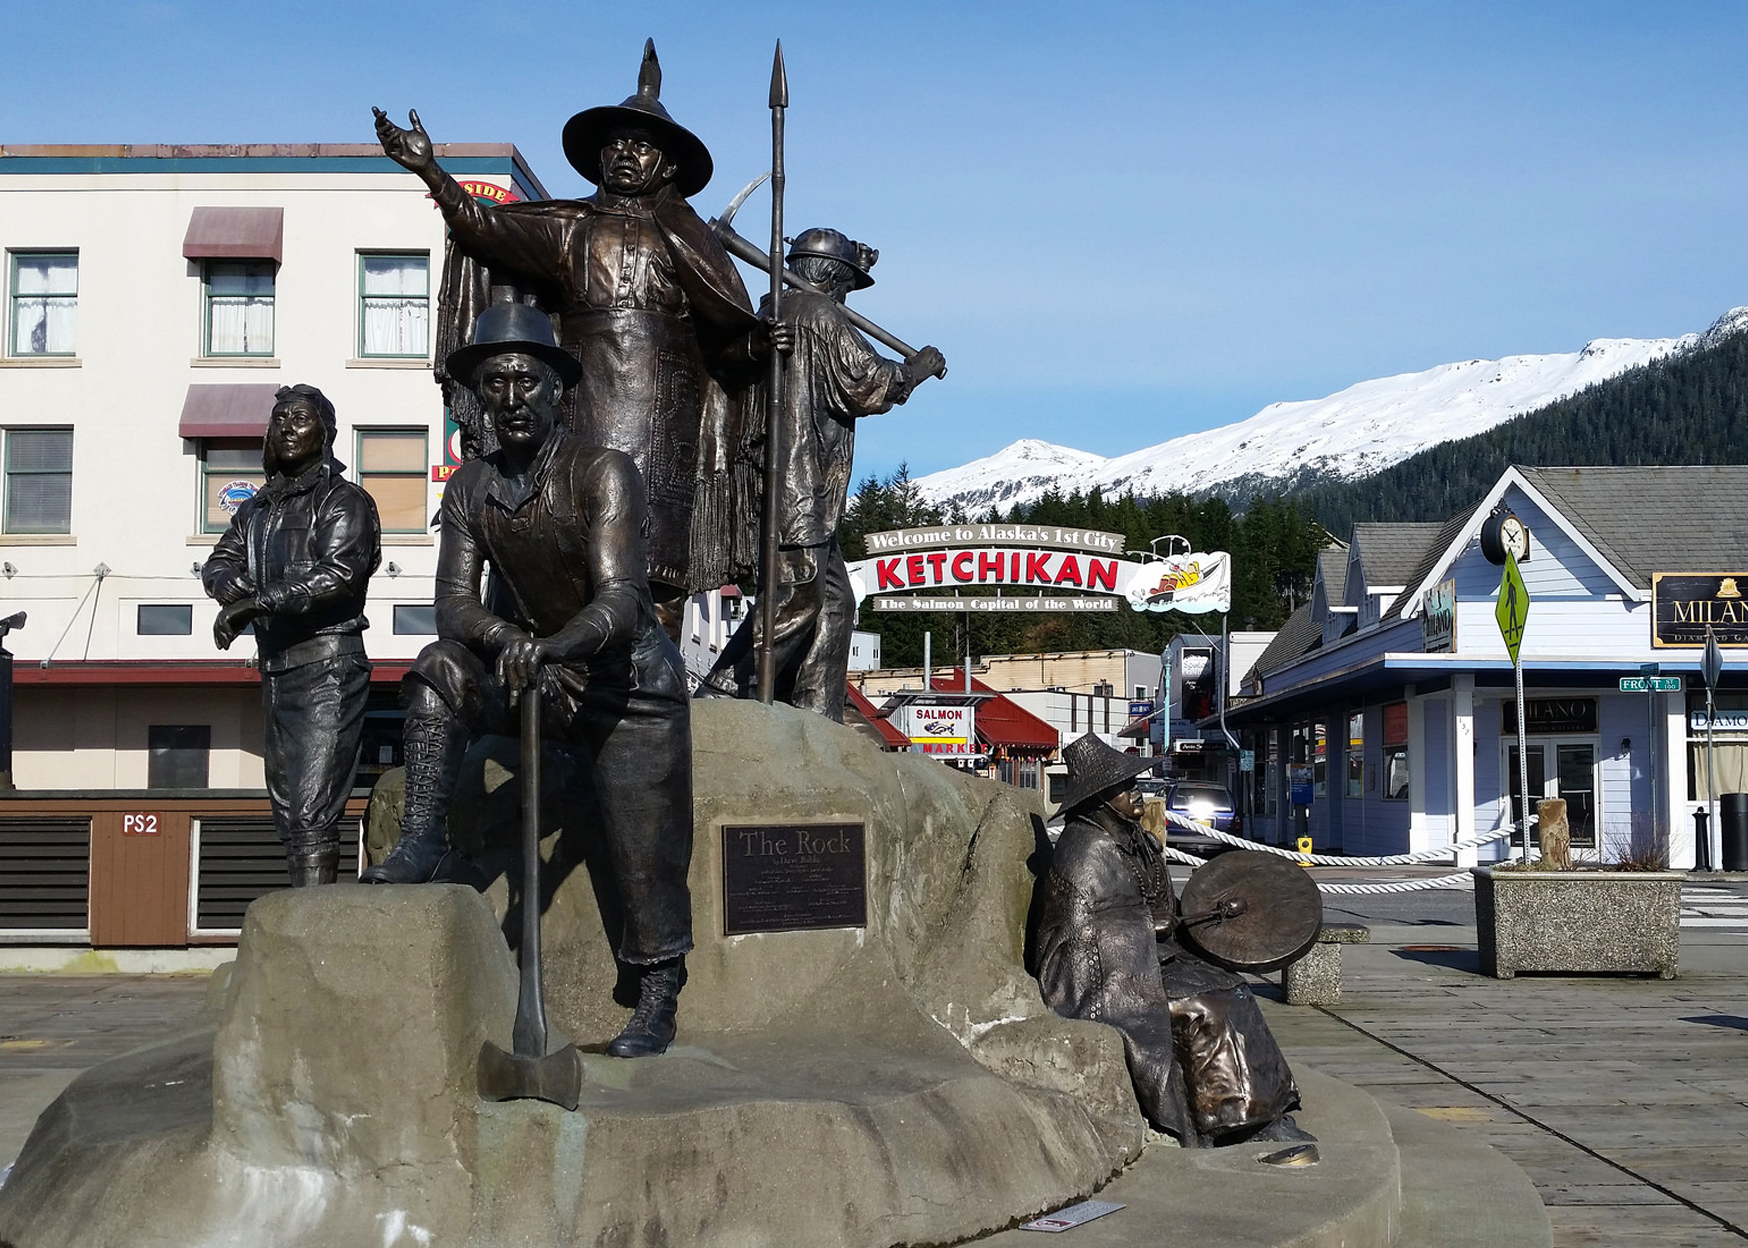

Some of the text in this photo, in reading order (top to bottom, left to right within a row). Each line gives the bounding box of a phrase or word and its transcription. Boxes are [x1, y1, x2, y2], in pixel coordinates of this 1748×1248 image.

[871, 526, 1118, 553] Welcome to Alaska's 1st City
[877, 551, 1119, 592] KETCHIKAN
[879, 598, 1114, 612] The Salmon Capital of the World
[1674, 634, 1728, 642] DIAMND
[1623, 680, 1661, 689] FRONT
[916, 709, 962, 720] SALMON
[1695, 712, 1748, 727] DAMO
[923, 744, 988, 754] MARKET
[124, 814, 157, 833] PS2
[739, 829, 851, 857] The Rock
